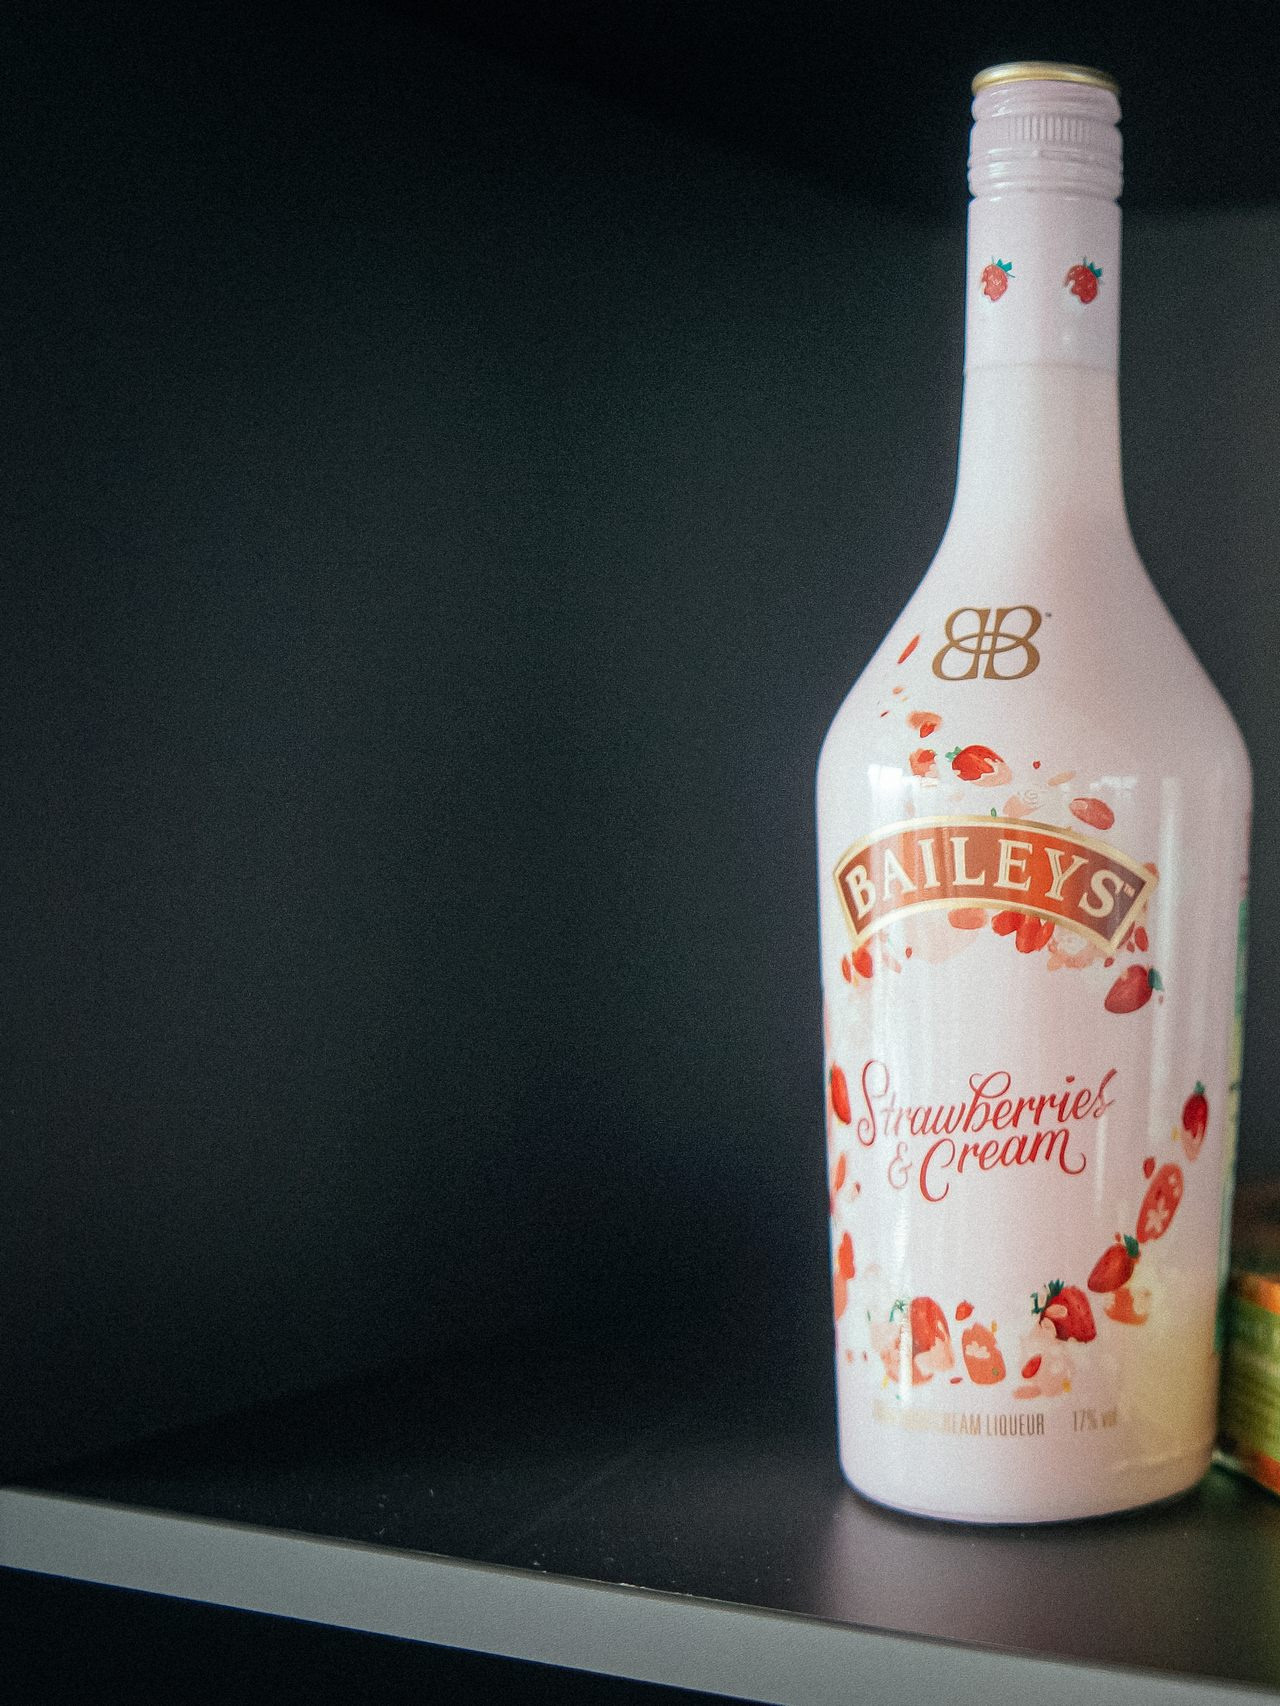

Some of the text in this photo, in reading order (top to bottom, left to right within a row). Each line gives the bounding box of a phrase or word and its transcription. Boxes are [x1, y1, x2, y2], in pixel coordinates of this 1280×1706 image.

[845, 836, 1126, 921] BAILEYS
[857, 1059, 1118, 1147] Strawberries
[887, 1127, 1087, 1203] & Cream
[986, 1412, 1045, 1436] LIQUEUR
